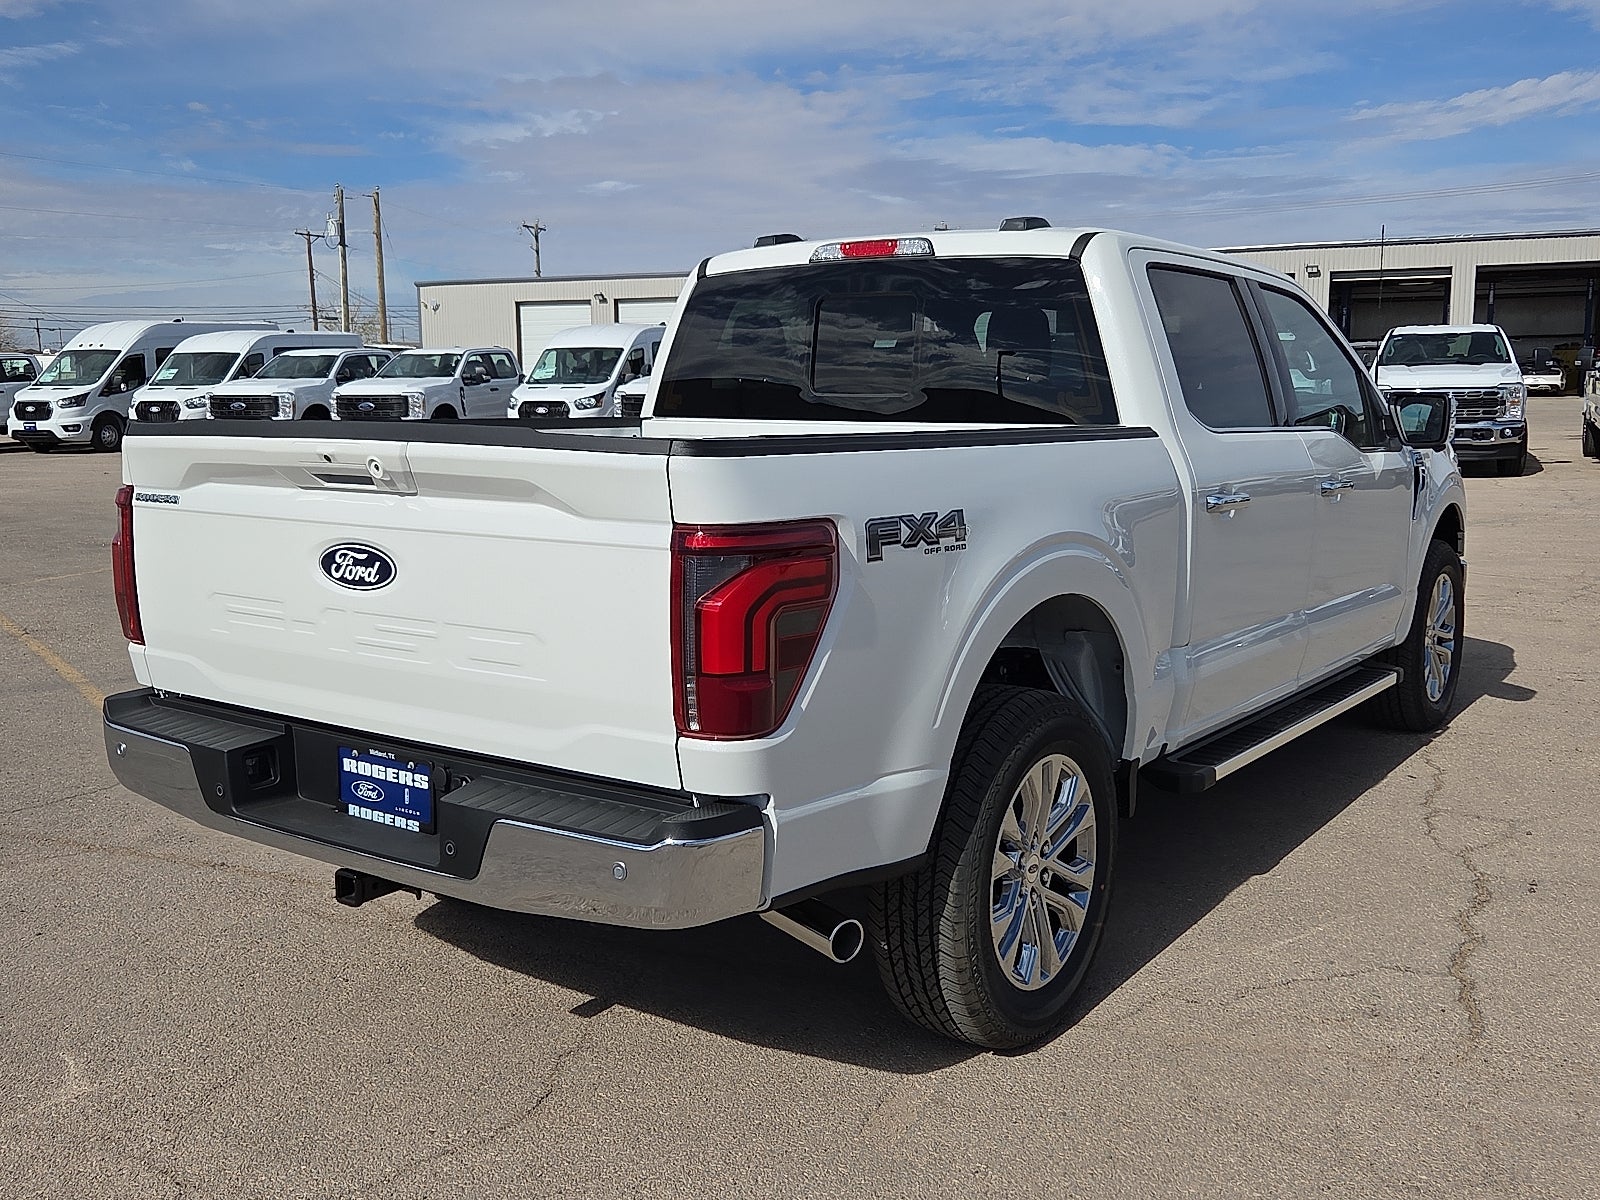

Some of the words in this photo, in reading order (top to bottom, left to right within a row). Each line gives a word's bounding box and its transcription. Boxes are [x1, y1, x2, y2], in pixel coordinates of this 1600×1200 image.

[865, 508, 968, 563] FX4
[924, 547, 942, 555] OFF
[944, 543, 967, 553] ROAD
[331, 549, 381, 583] Ford
[342, 757, 429, 790] ROGERS
[357, 783, 378, 799] Ford
[348, 803, 420, 833] ROGERS
